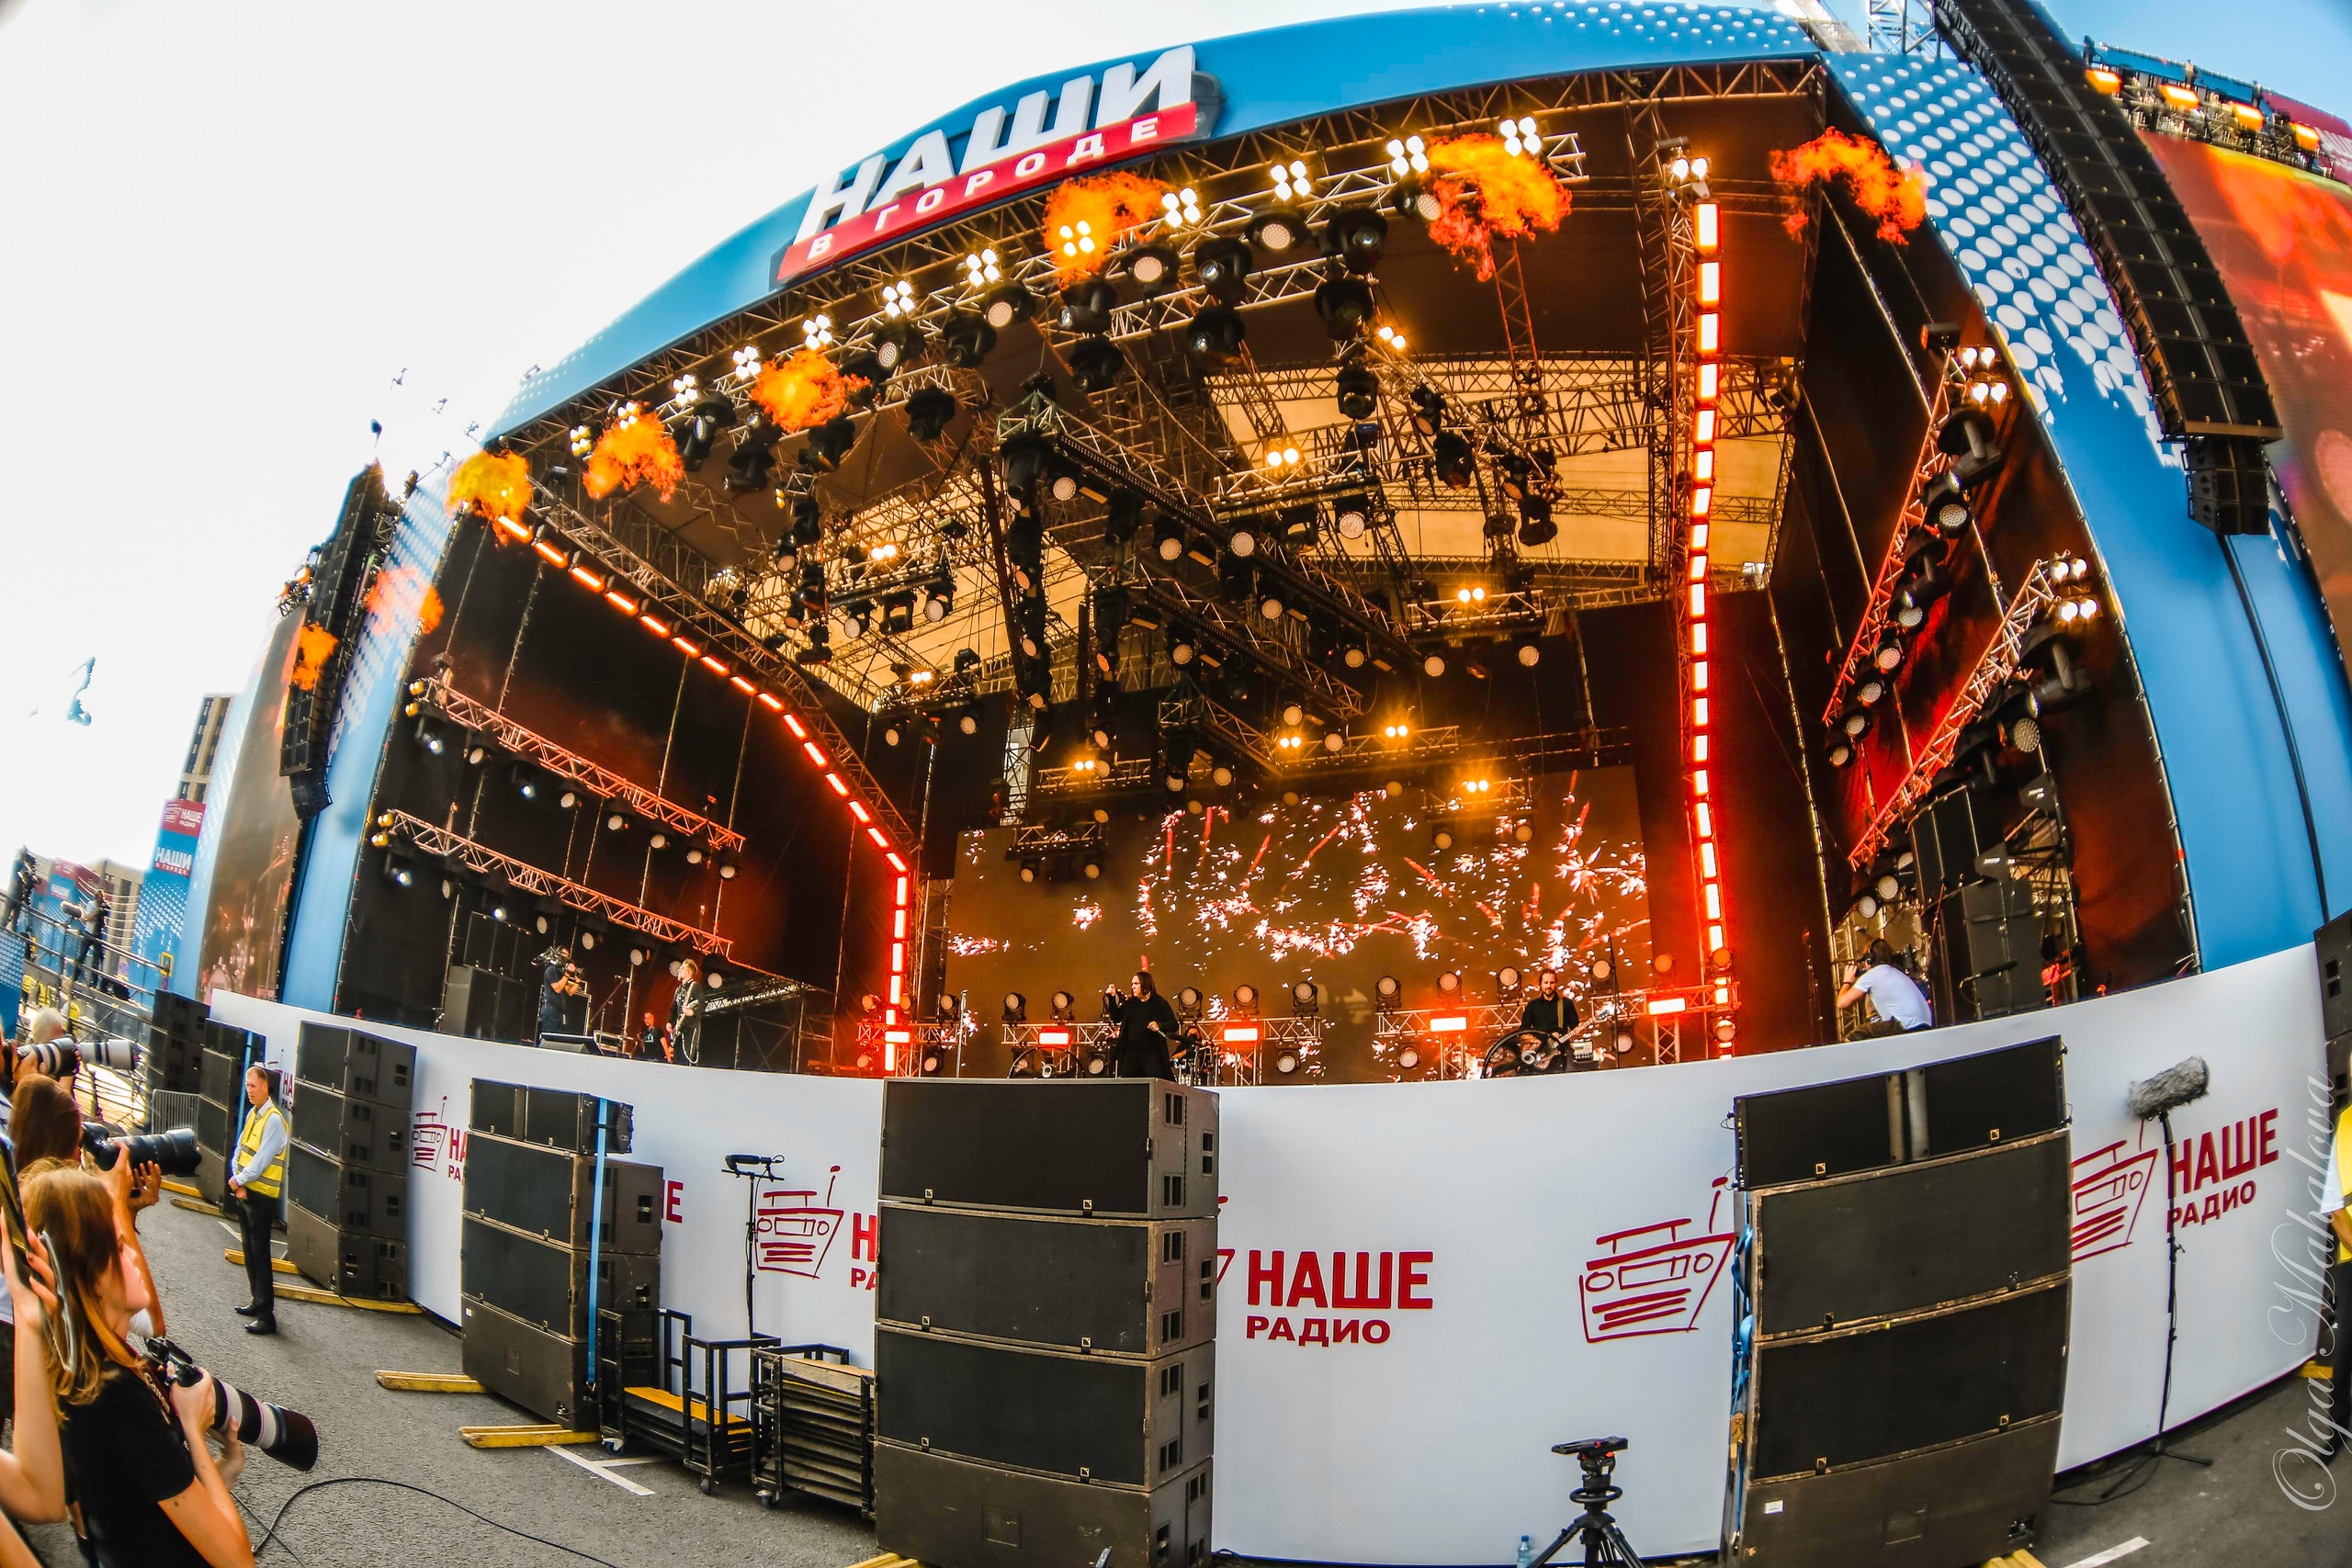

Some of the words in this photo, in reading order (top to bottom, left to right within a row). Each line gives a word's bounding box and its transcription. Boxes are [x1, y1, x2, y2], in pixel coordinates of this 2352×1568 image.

[793, 44, 1196, 246] НАШИ
[807, 232, 831, 261] В
[875, 117, 1159, 231] ГОРОДЕ
[180, 808, 203, 823] НАШЕ
[154, 846, 192, 870] НАШИ
[282, 1071, 293, 1098] НА
[448, 1127, 468, 1163] НА
[2172, 1108, 2279, 1195] НАШЕ
[2166, 1179, 2256, 1234] РАДИО
[1247, 1249, 1434, 1310] НАШЕ
[1245, 1314, 1392, 1348] РАДИО
[143, 1371, 170, 1414] Canon
